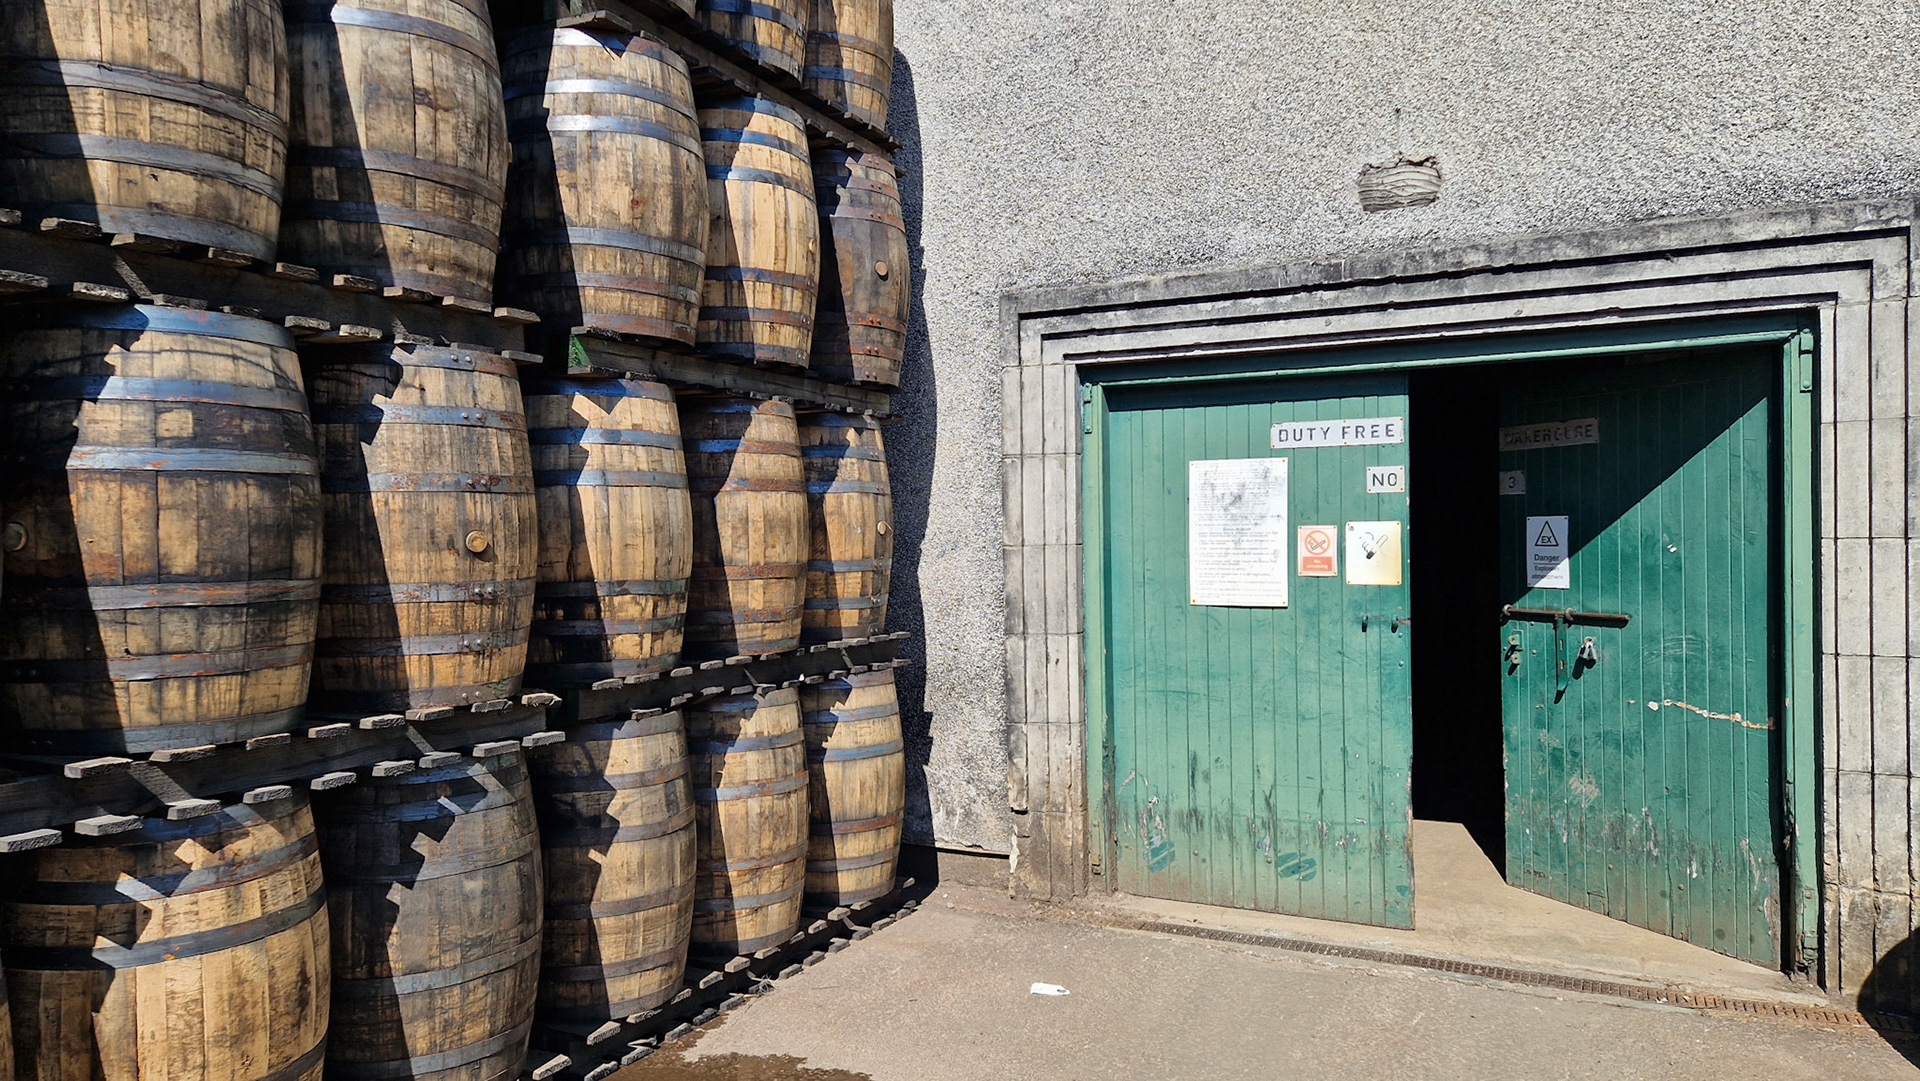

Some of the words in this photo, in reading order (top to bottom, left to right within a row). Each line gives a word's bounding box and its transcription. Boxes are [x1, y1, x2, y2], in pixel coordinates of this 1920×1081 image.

[1279, 427, 1331, 442] DUTY
[1342, 424, 1395, 439] FREE
[1372, 473, 1398, 487] NO
[1508, 476, 1516, 488] 3
[1541, 535, 1552, 544] EX
[1534, 553, 1560, 562] Danger
